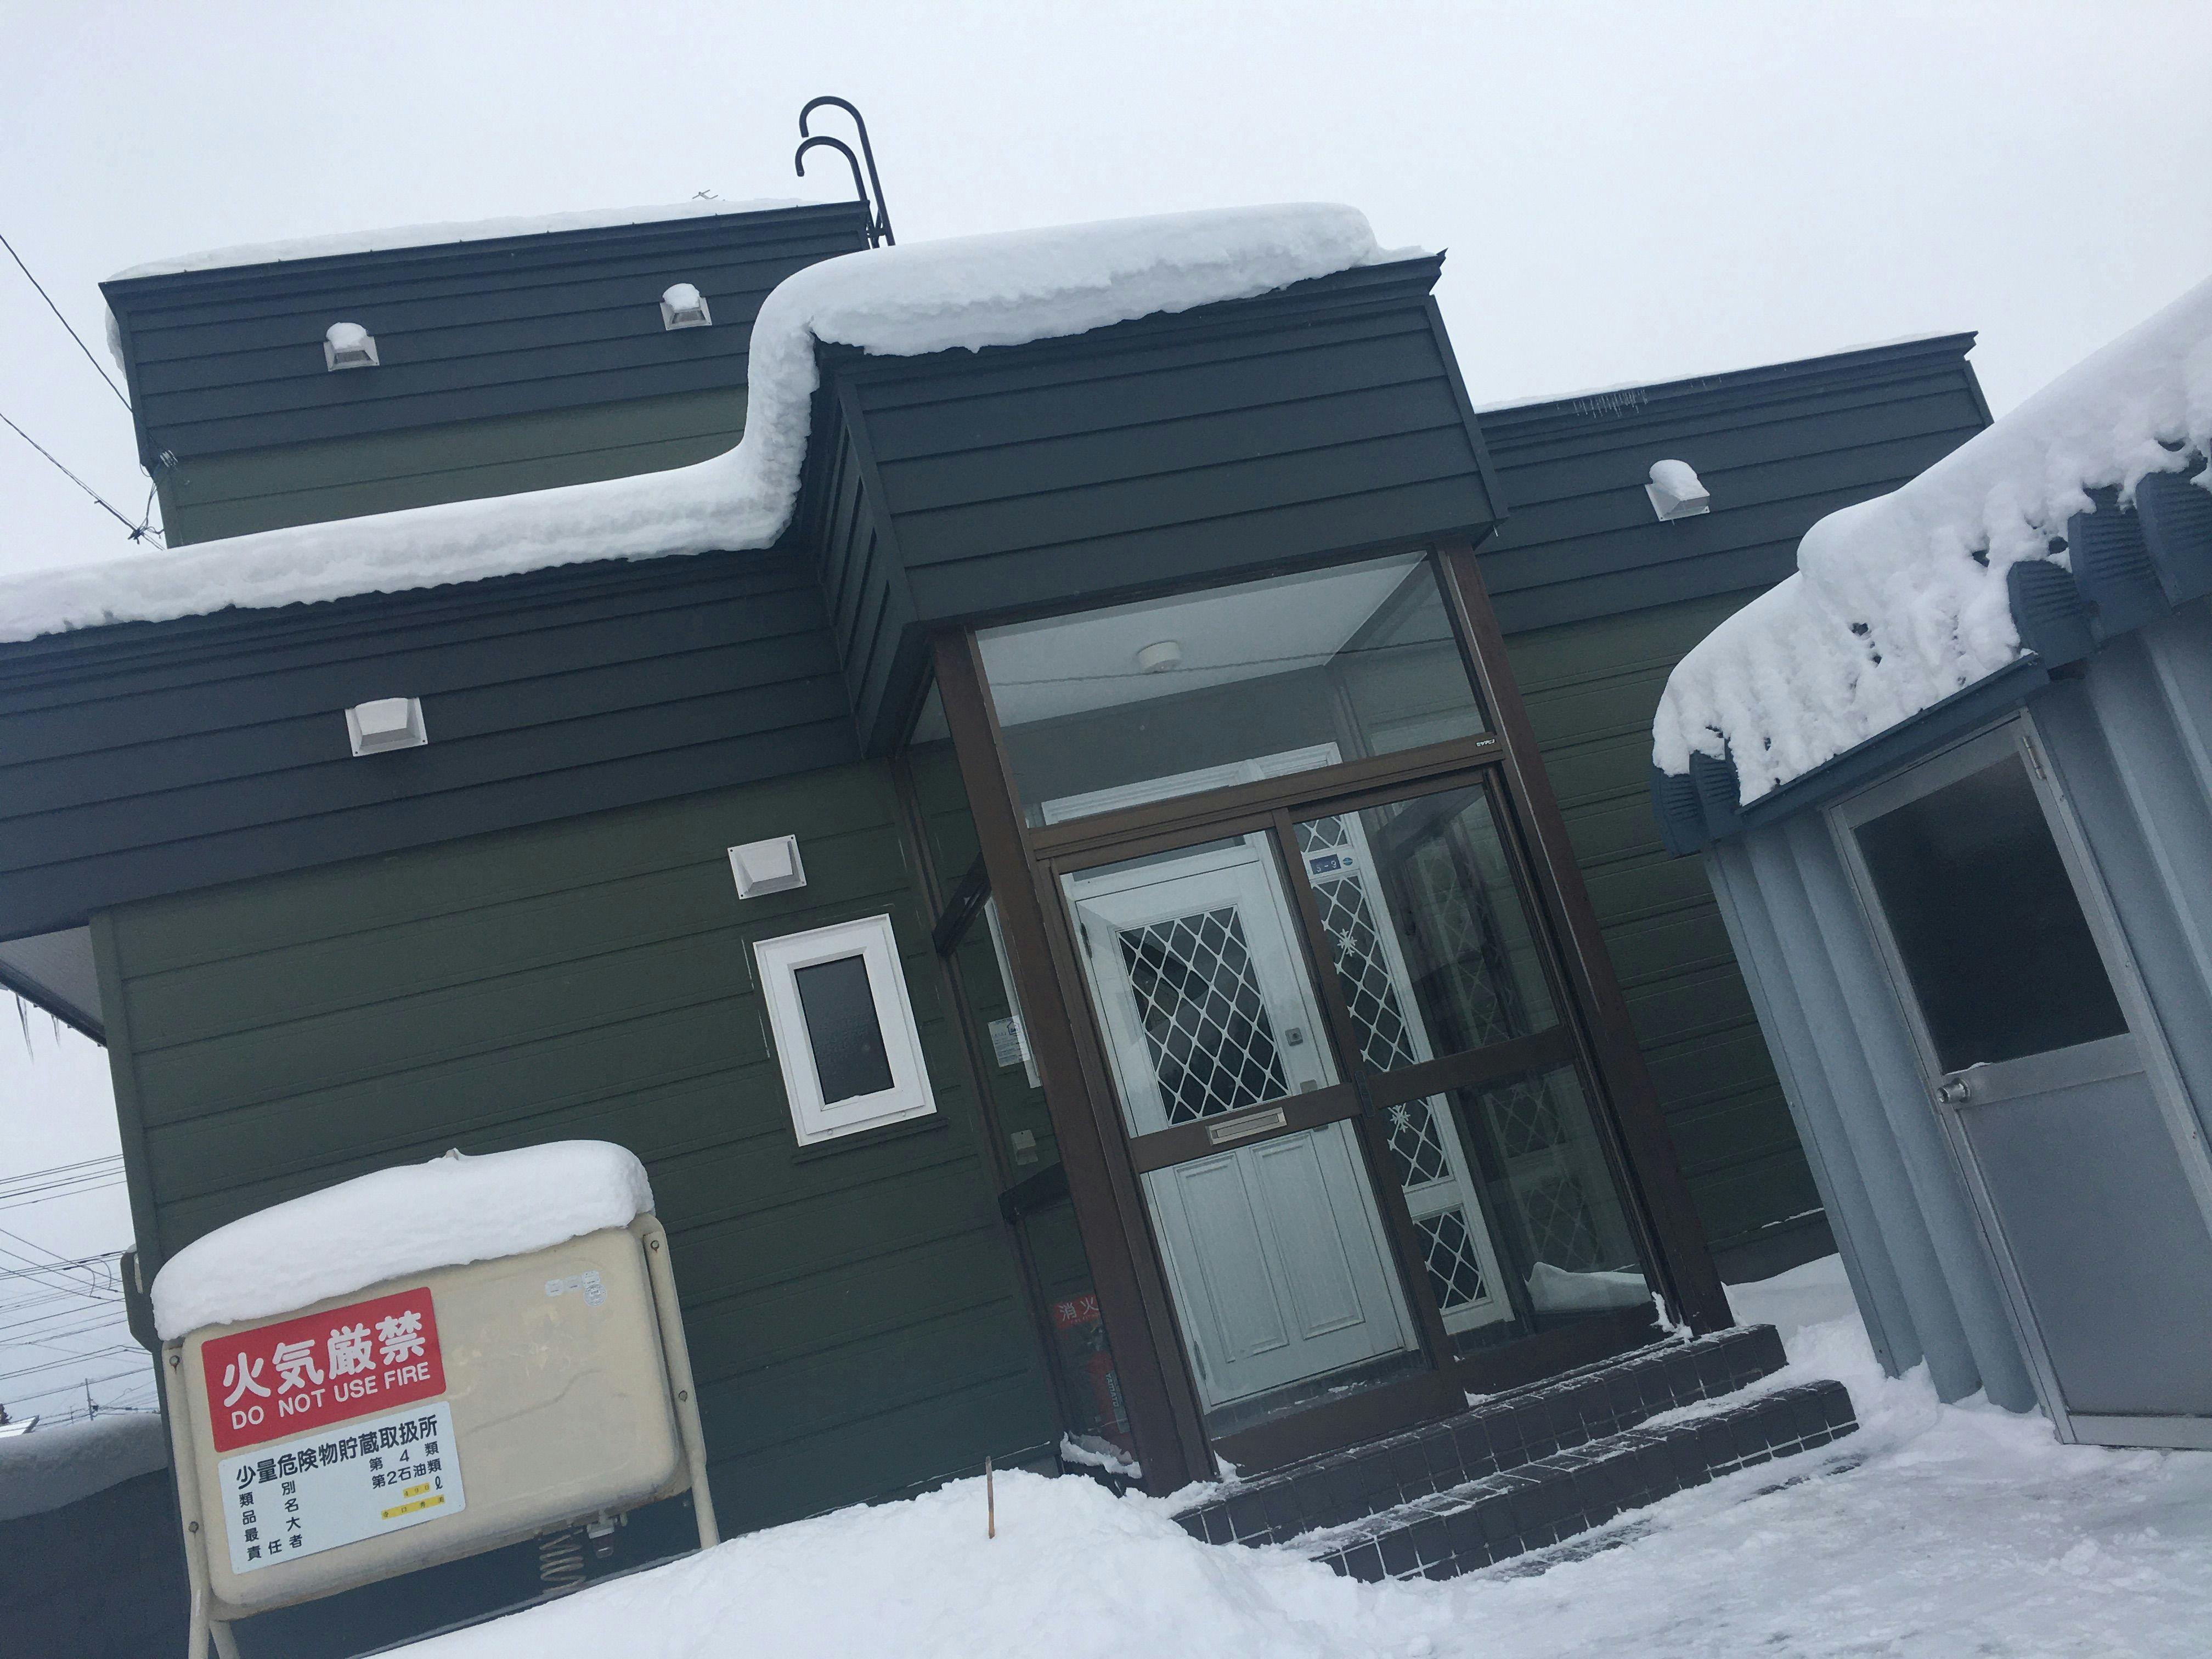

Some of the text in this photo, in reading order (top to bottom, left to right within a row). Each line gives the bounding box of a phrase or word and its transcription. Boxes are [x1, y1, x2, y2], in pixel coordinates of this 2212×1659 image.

[223, 1310, 425, 1407] 火気厳禁
[232, 1362, 430, 1429] DO NOT USE FIRE
[236, 1414, 437, 1489] 少量危険物貯蔵取扱所
[371, 1458, 442, 1489] 第2石油類
[246, 1533, 302, 1561] 責任者
